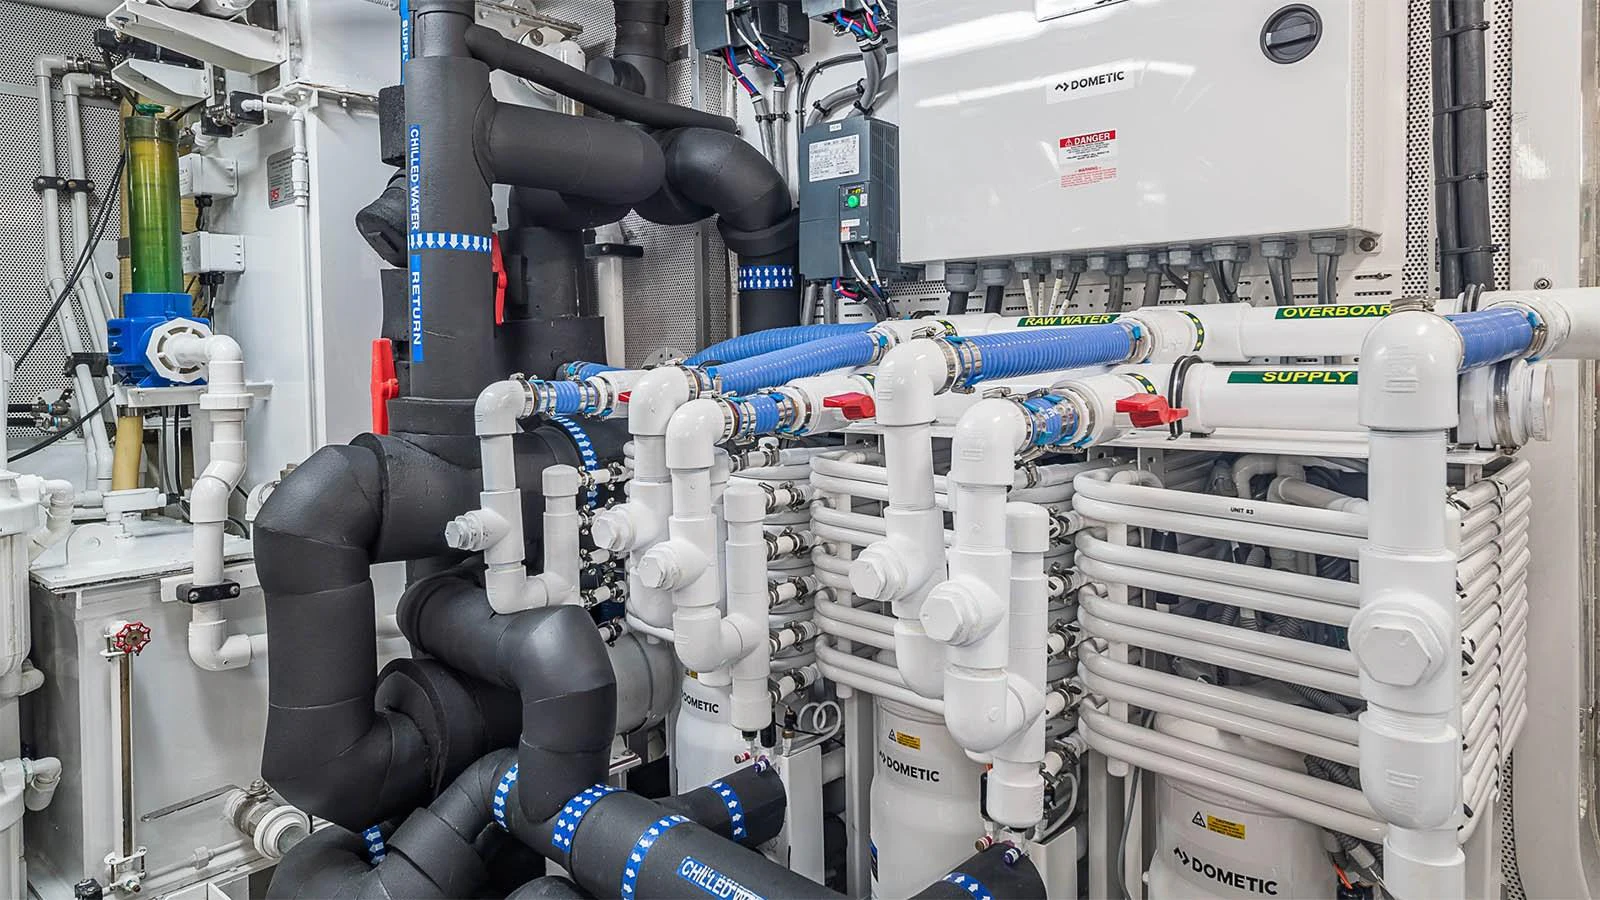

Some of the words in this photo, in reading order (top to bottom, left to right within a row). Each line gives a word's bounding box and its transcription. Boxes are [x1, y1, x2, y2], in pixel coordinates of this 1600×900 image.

[1071, 71, 1125, 90] DOMETIC
[1074, 132, 1111, 145] DANGER
[410, 128, 419, 183] CHILLED
[411, 185, 420, 231] WATER
[411, 271, 422, 345] RETURN
[1024, 316, 1058, 326] RAW
[1060, 314, 1112, 325] WATER
[1283, 305, 1392, 318] OVERBOAR
[1262, 371, 1353, 383] SUPPLY
[886, 755, 940, 782] DOMETIC
[681, 860, 733, 898] CHILLED
[1191, 856, 1278, 896] DOMETIC
